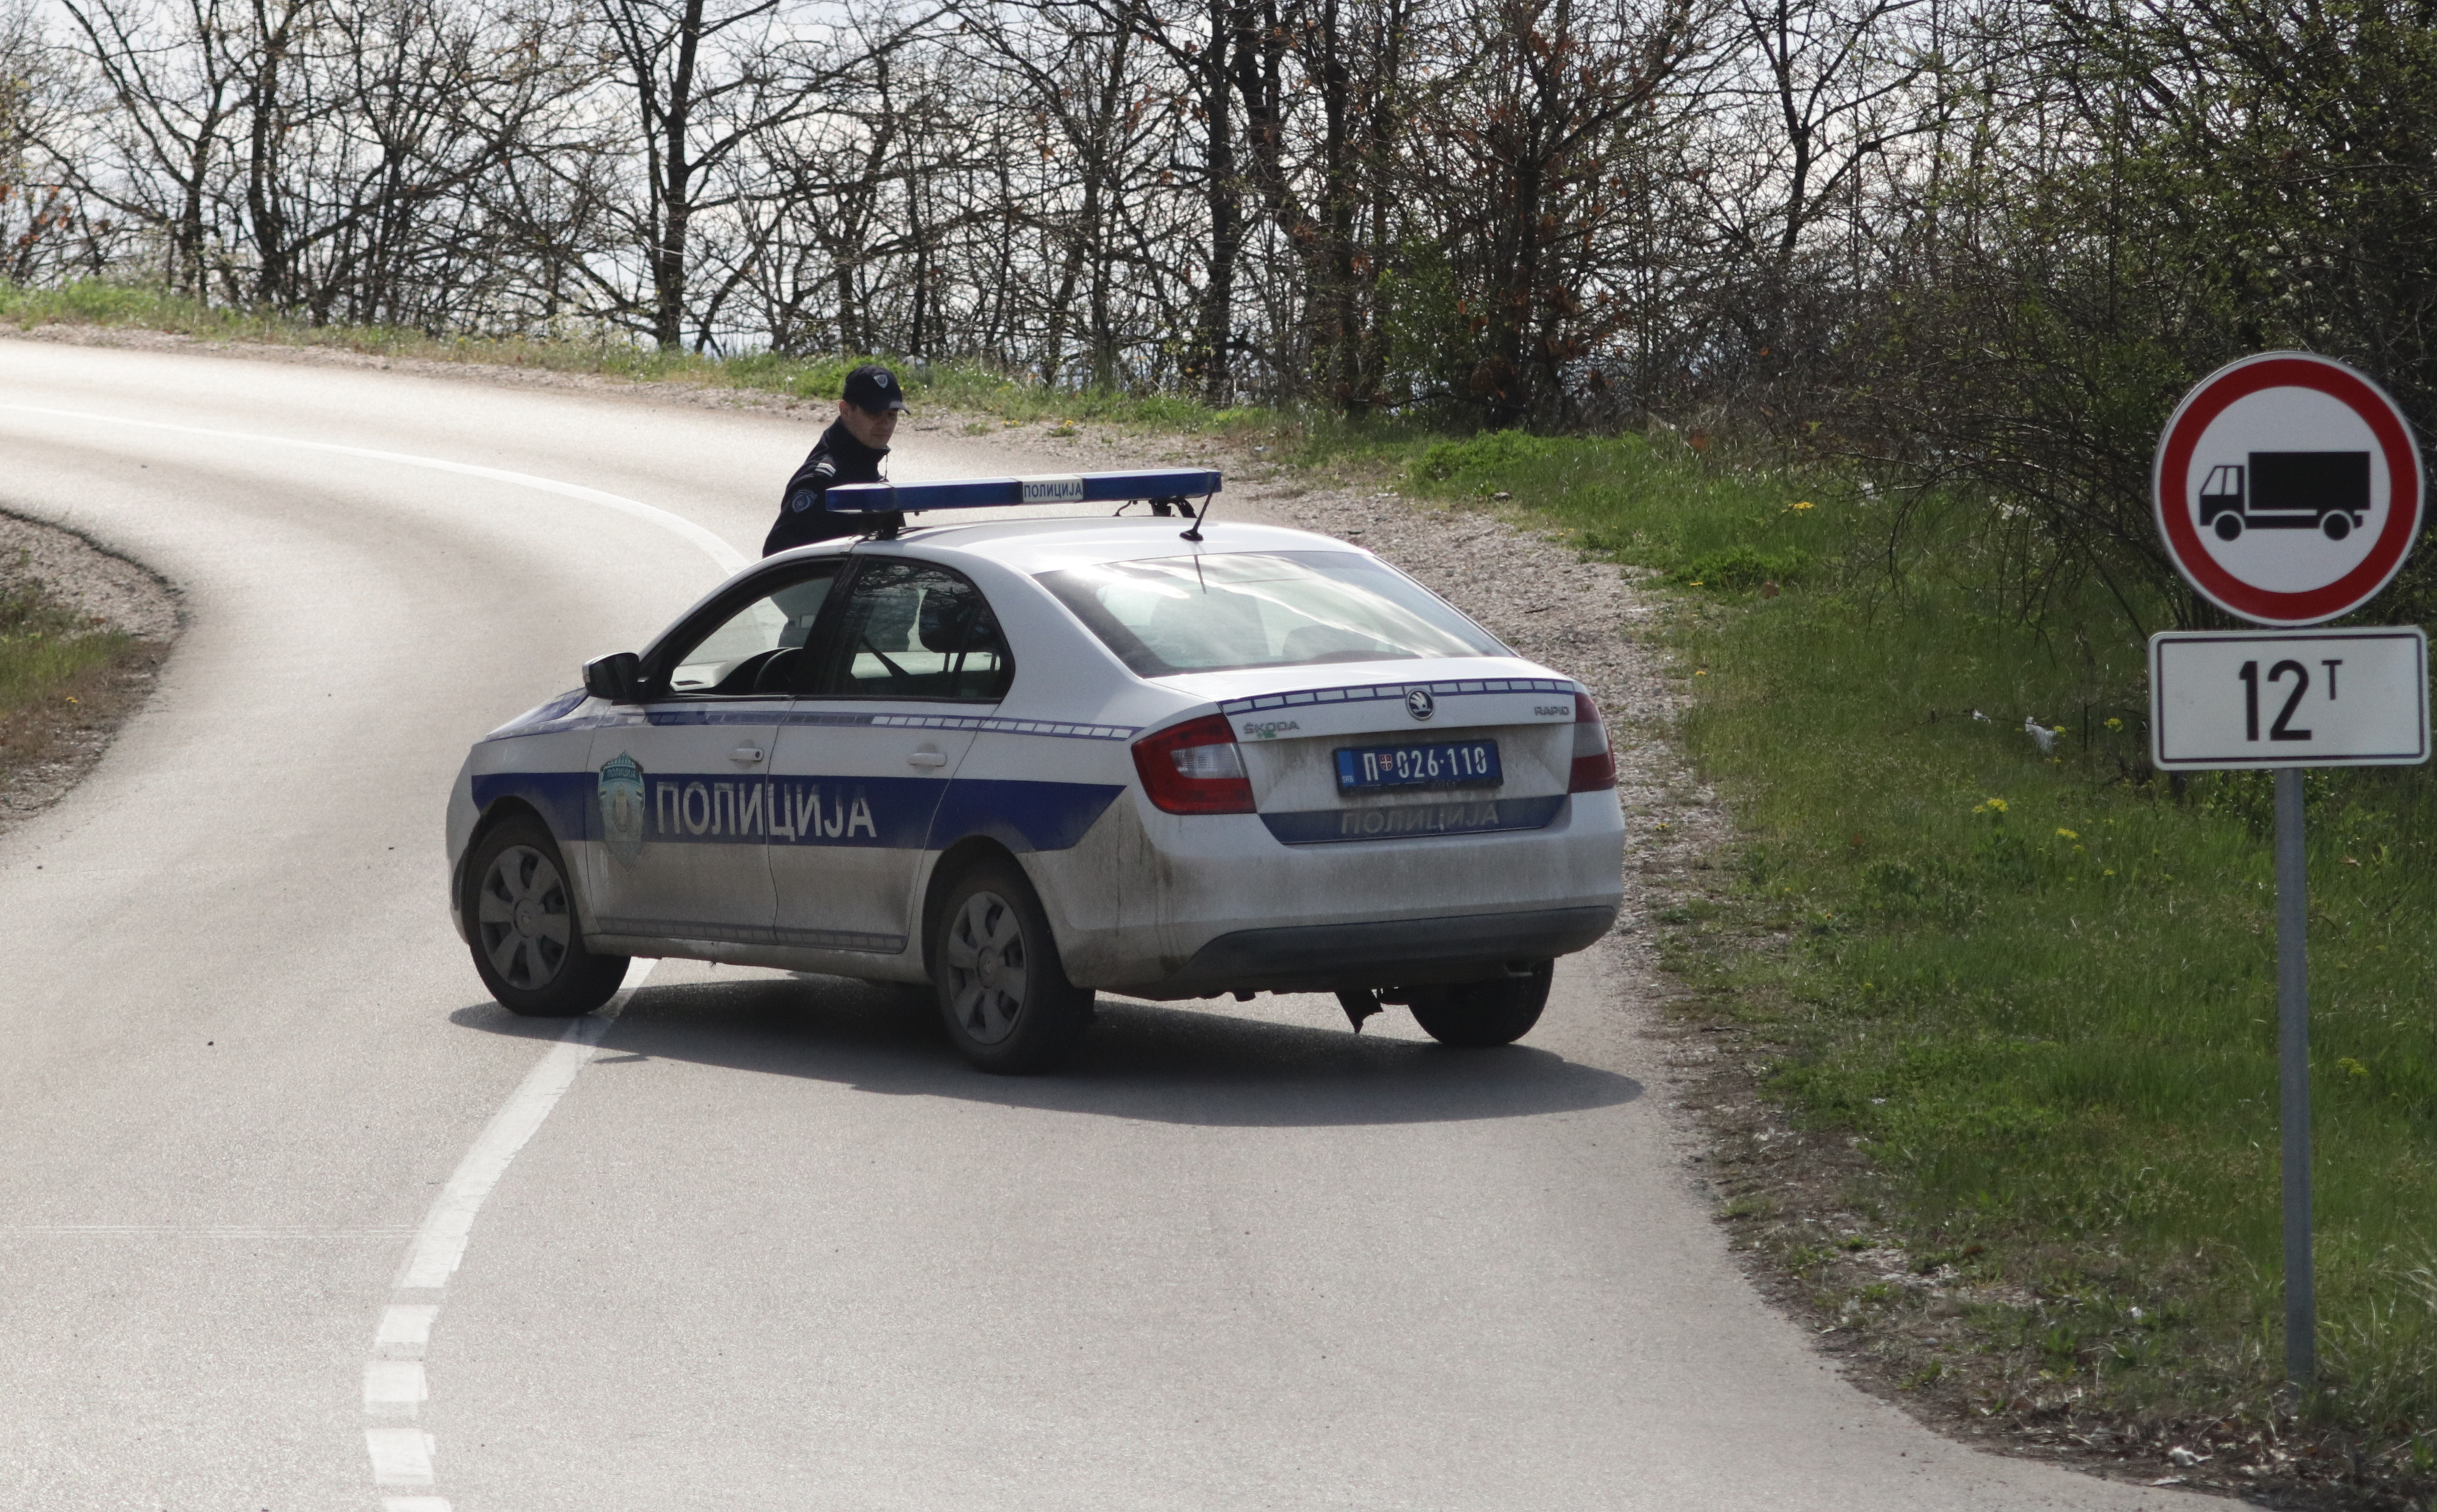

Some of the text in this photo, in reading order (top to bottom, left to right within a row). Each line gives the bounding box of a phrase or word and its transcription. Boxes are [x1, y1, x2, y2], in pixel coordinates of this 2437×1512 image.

[1024, 483, 1082, 499] ПОЛИЦИЈА
[1534, 706, 1571, 716] RAPID
[1363, 753, 1379, 781] П
[1342, 775, 1355, 784] SRB
[657, 781, 877, 842] ПОЛИЦИЈА
[1341, 802, 1499, 835] ПОЛИЦИЈА
